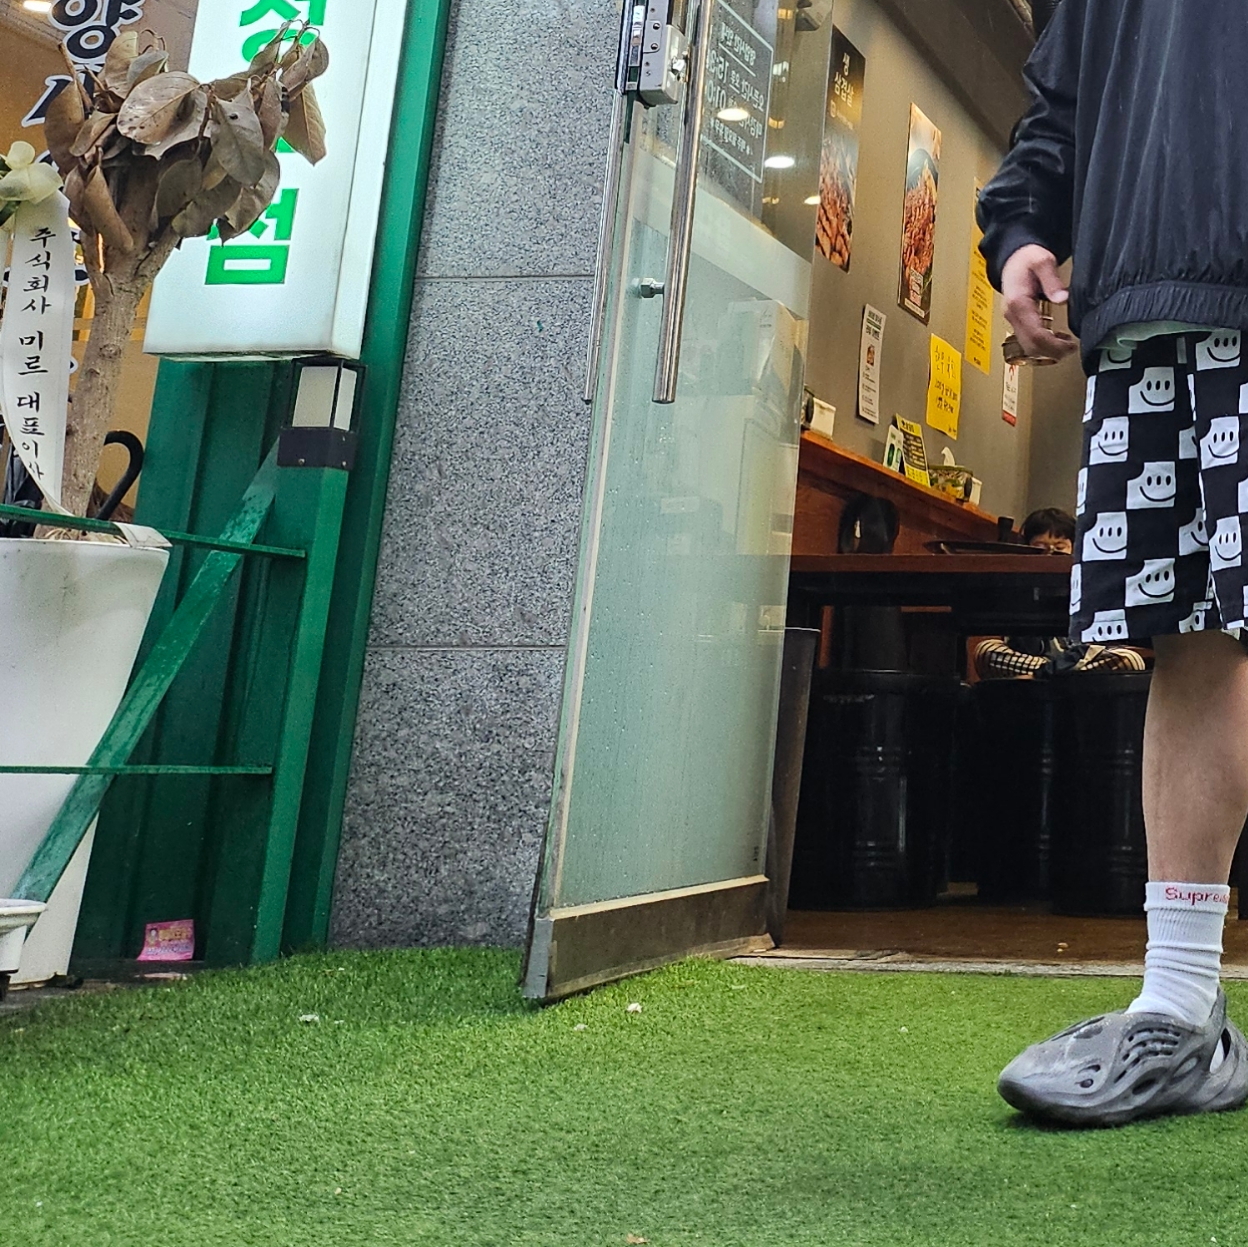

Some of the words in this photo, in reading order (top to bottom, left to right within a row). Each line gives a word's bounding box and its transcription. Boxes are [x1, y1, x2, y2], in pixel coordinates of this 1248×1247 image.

[22, 228, 57, 315] 주식회사
[17, 330, 48, 376] 미르
[17, 391, 46, 481] 대표이사
